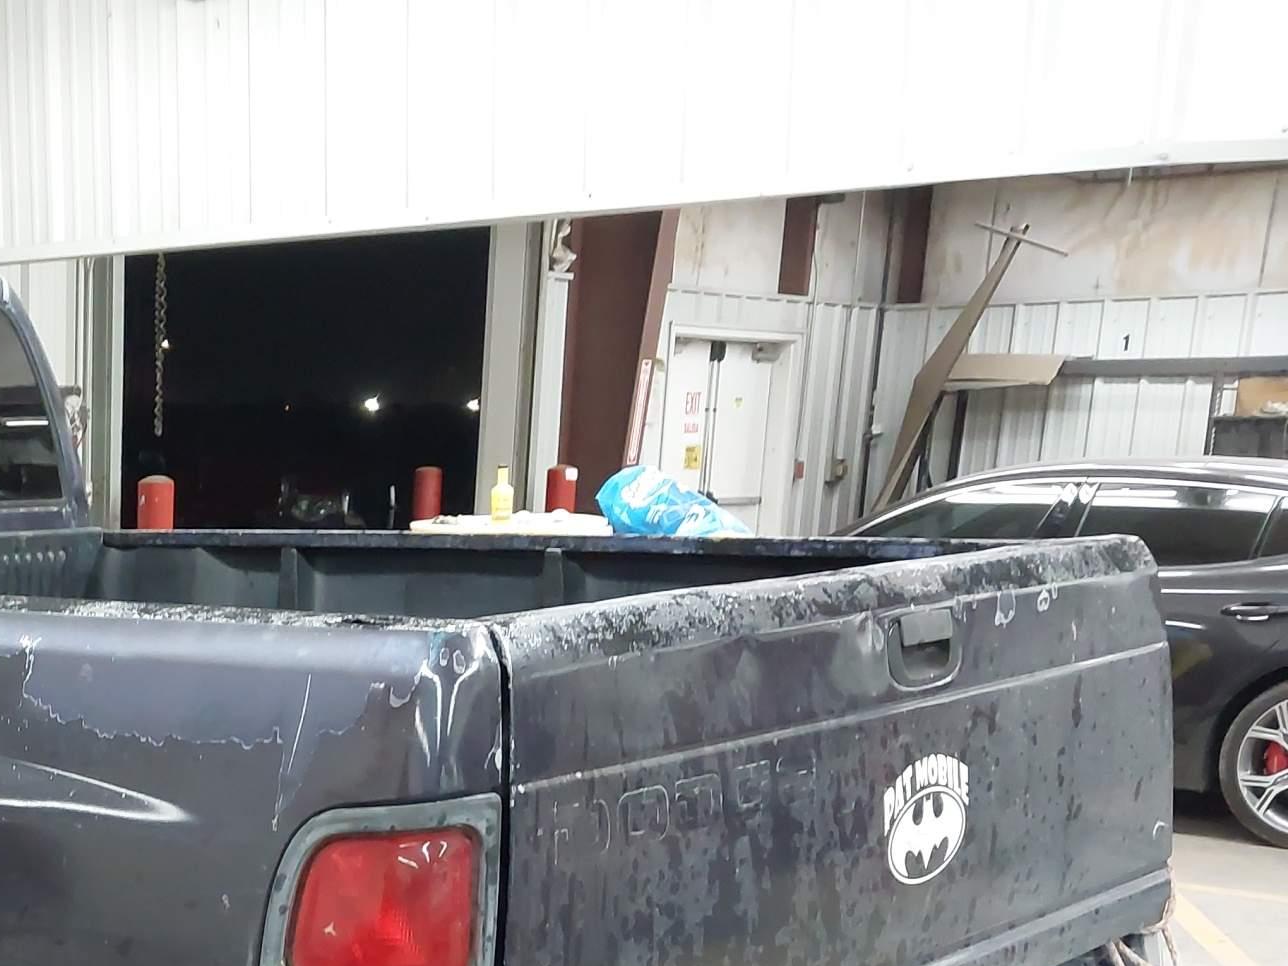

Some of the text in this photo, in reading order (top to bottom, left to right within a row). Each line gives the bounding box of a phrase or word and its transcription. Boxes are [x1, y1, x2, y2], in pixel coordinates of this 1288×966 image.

[1122, 333, 1131, 352] 1
[685, 391, 702, 415] EXIT
[914, 753, 970, 807] MOBILE
